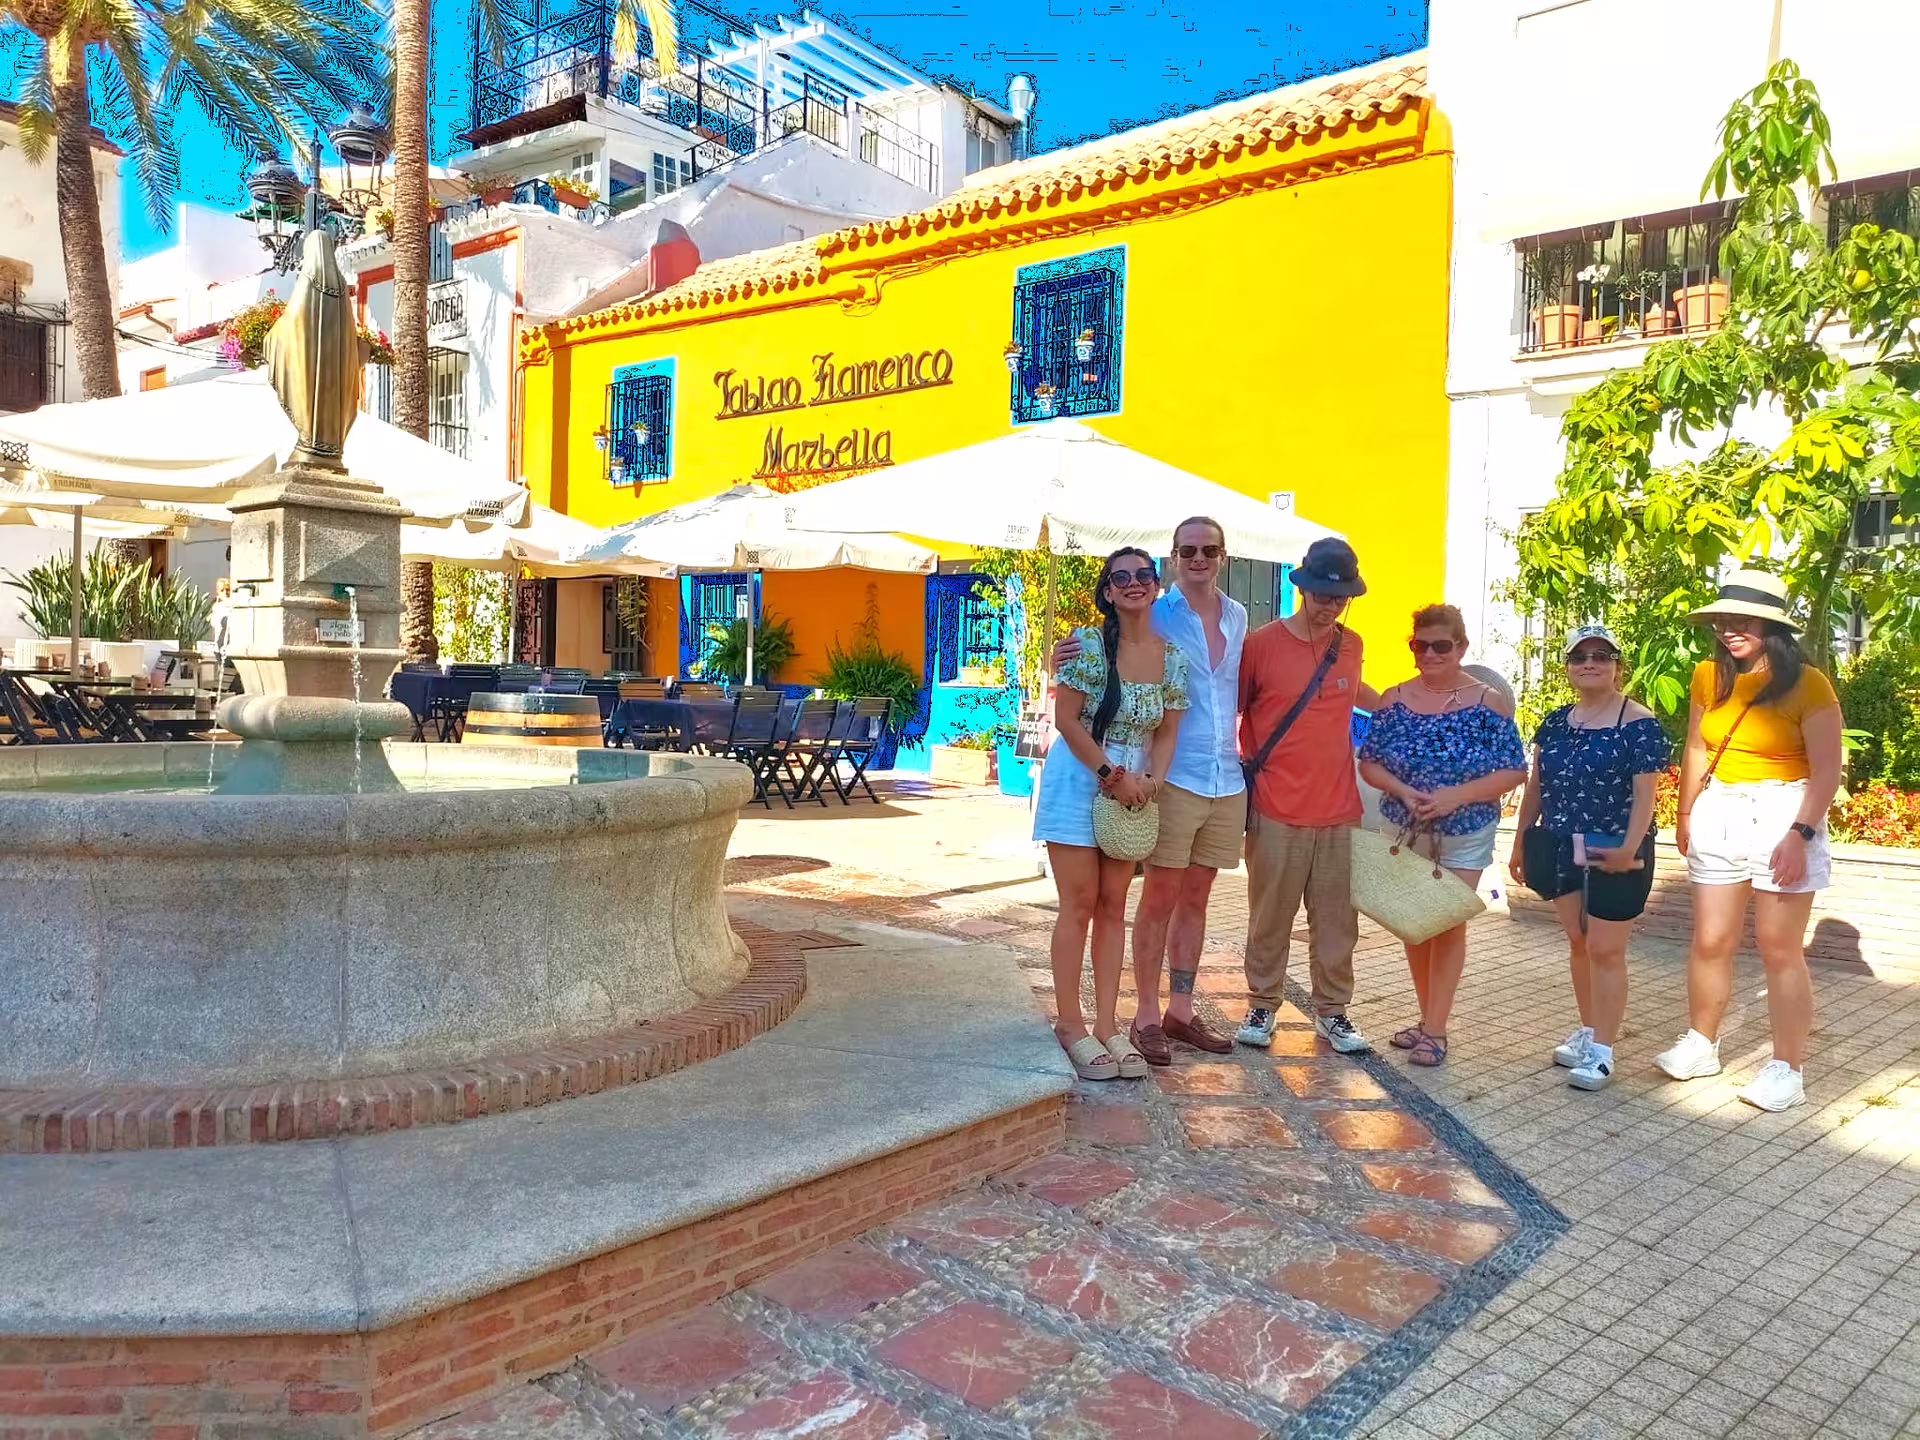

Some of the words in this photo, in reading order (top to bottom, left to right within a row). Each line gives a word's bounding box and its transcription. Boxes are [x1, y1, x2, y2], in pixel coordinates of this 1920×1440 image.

[713, 368, 804, 418] Tablao
[811, 349, 953, 402] Flamenco
[754, 424, 893, 477] Marbella
[469, 499, 504, 509] CERVEZAS
